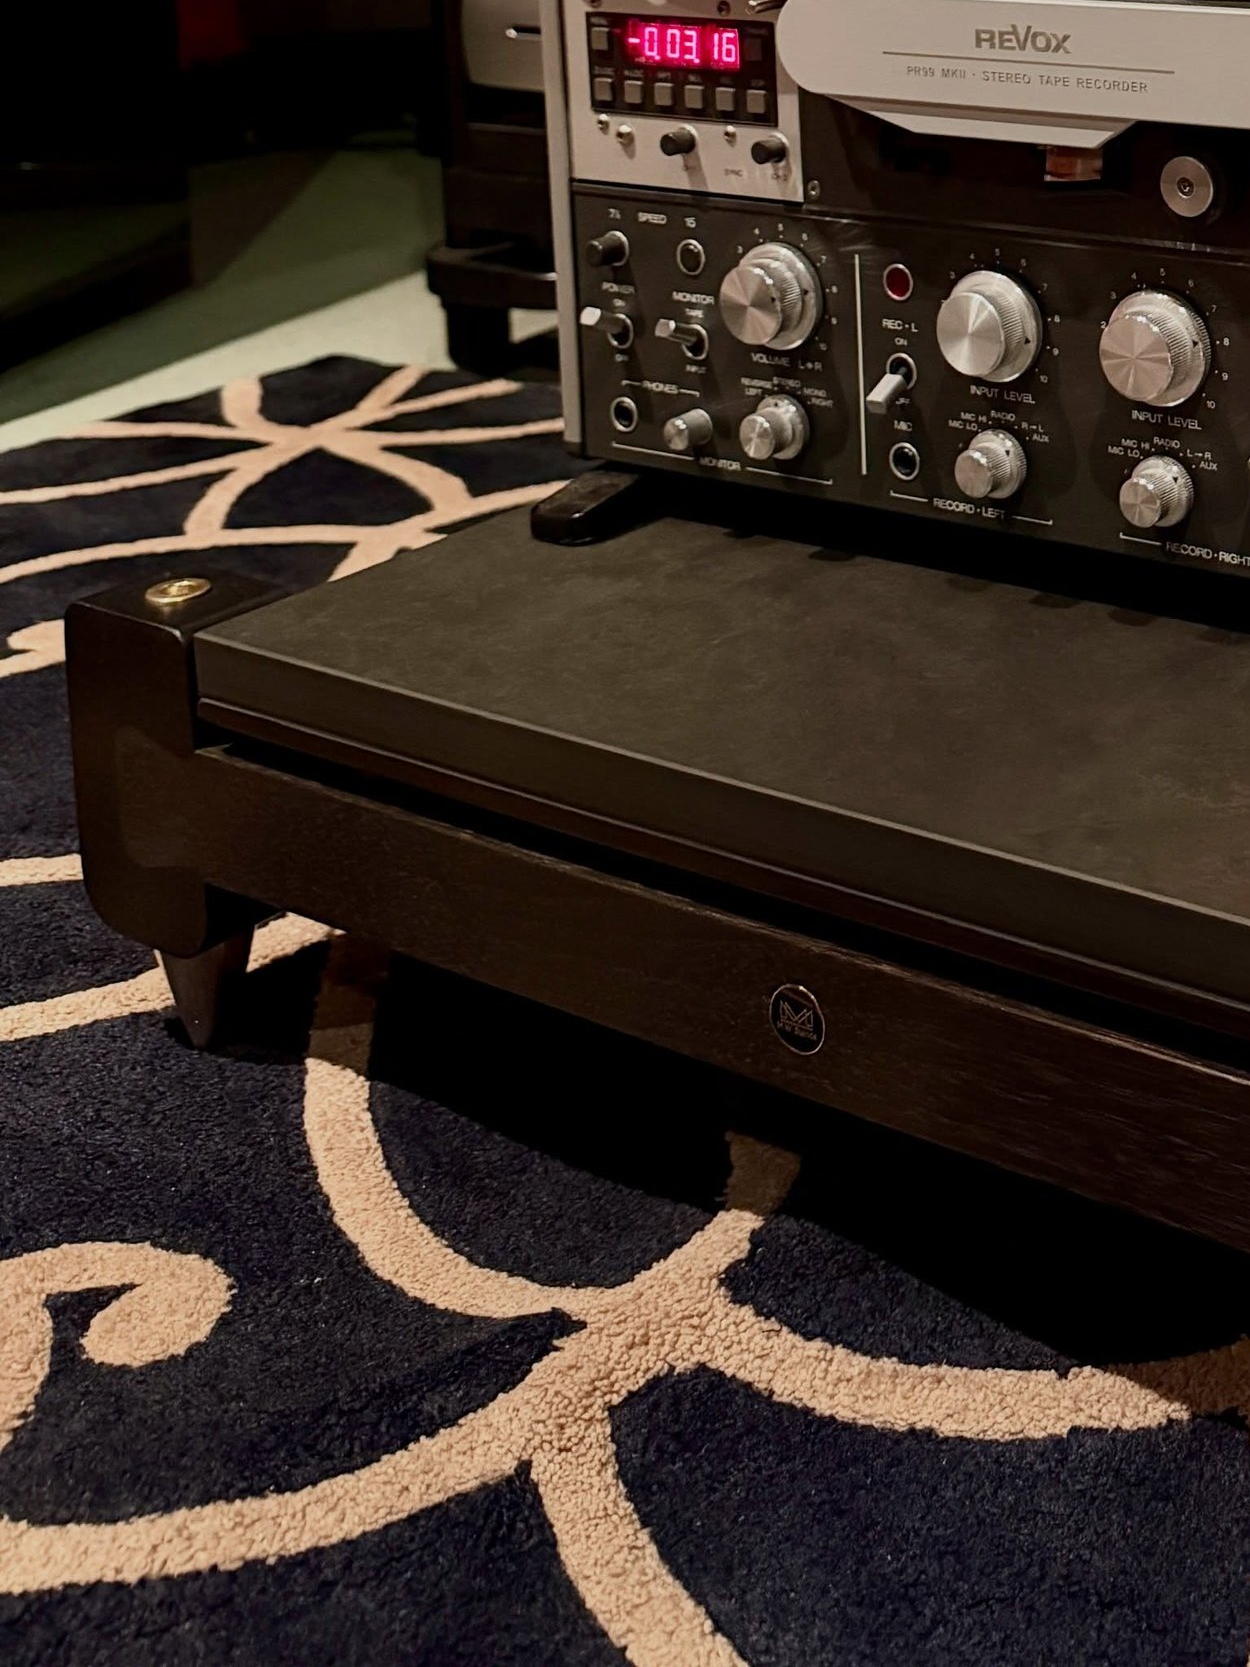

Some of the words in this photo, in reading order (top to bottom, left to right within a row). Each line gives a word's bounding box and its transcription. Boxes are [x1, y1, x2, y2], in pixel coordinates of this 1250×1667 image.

[907, 65, 935, 77] PR99
[982, 71, 1031, 85] STEREO
[1039, 75, 1070, 87] TAPE
[1076, 78, 1148, 93] RECORDER
[673, 291, 715, 305] MONITOR
[882, 318, 903, 330] REC
[970, 385, 999, 398] INPUT
[1004, 391, 1036, 404] LEVEL
[894, 420, 913, 432] MIC
[1132, 410, 1163, 423] INPUT
[1168, 415, 1202, 430] LEVEL
[1121, 438, 1138, 448] MIC
[1141, 441, 1150, 450] HI
[1153, 436, 1180, 449] RADIO
[1108, 445, 1124, 455] MIC
[1127, 449, 1140, 458] LO
[1200, 461, 1218, 471] AUX
[933, 498, 975, 514] RECORD
[1166, 541, 1213, 560] RECORD
